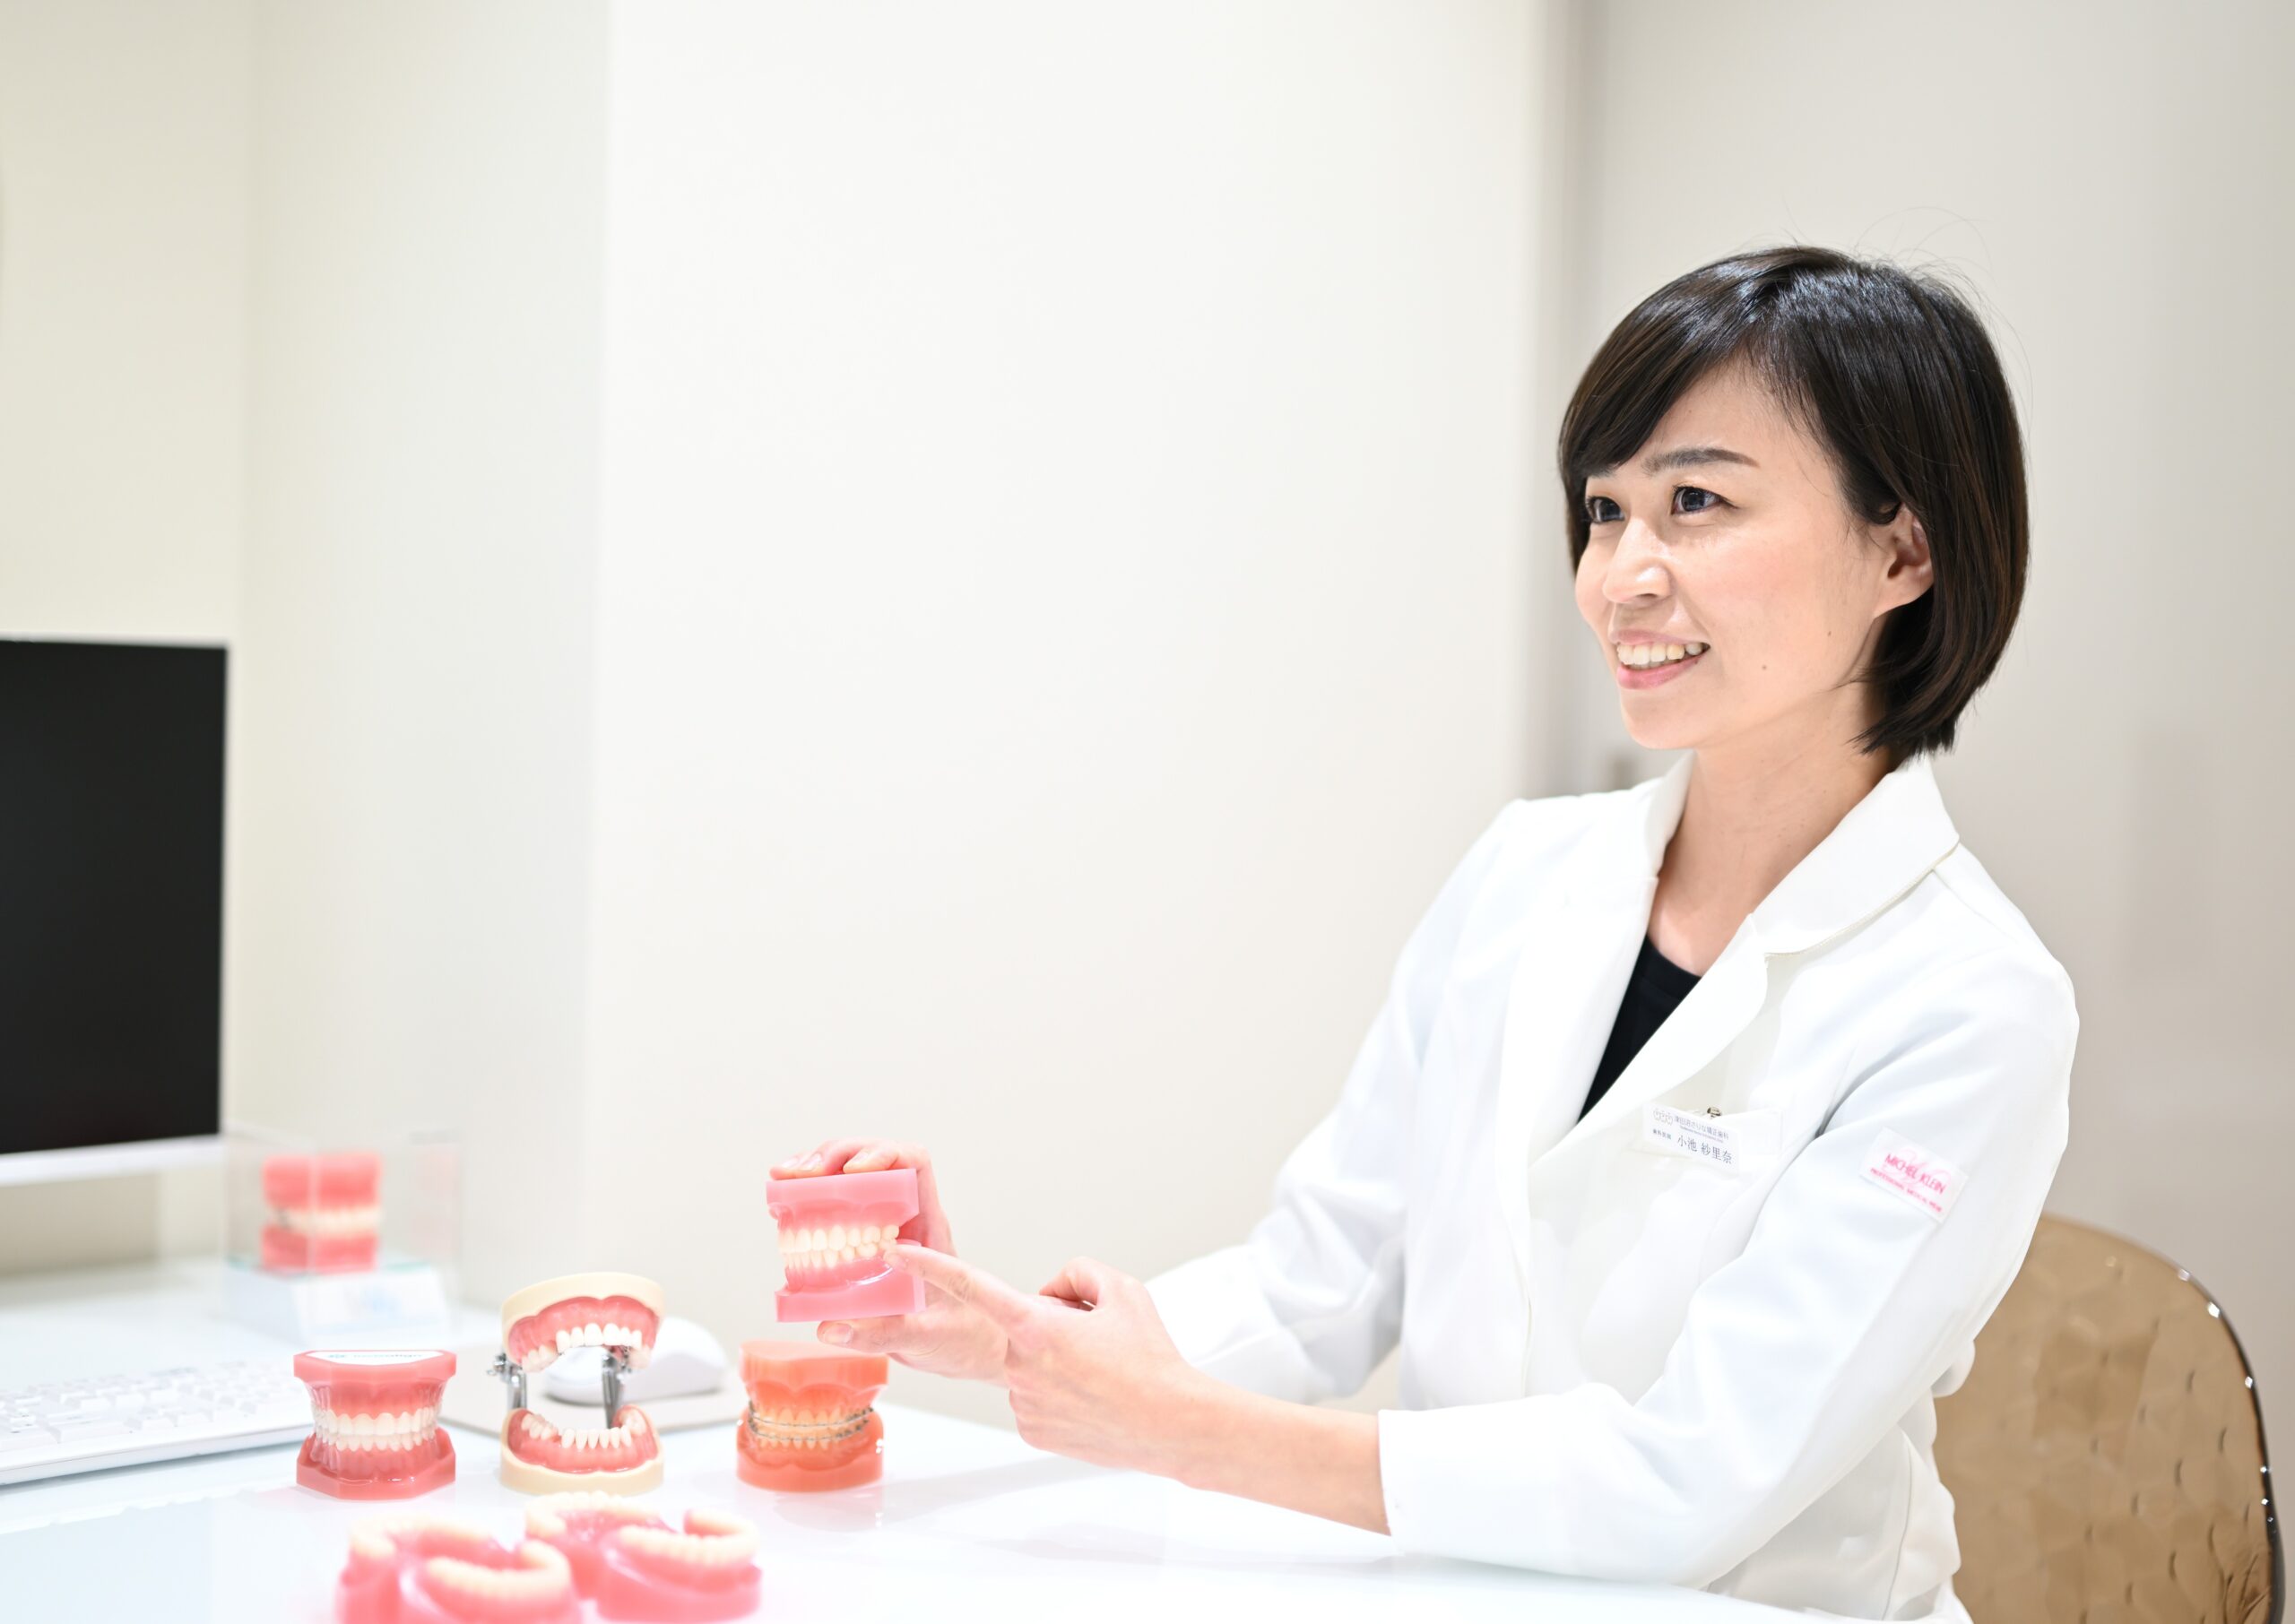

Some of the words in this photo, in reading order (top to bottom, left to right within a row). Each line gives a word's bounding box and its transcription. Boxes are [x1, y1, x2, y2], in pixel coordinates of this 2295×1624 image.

[1677, 1135, 1698, 1153] 小池
[1701, 1142, 1732, 1165] 紗里奈
[1884, 1153, 1918, 1179] MICHEL
[1919, 1172, 1947, 1195] KLEIN
